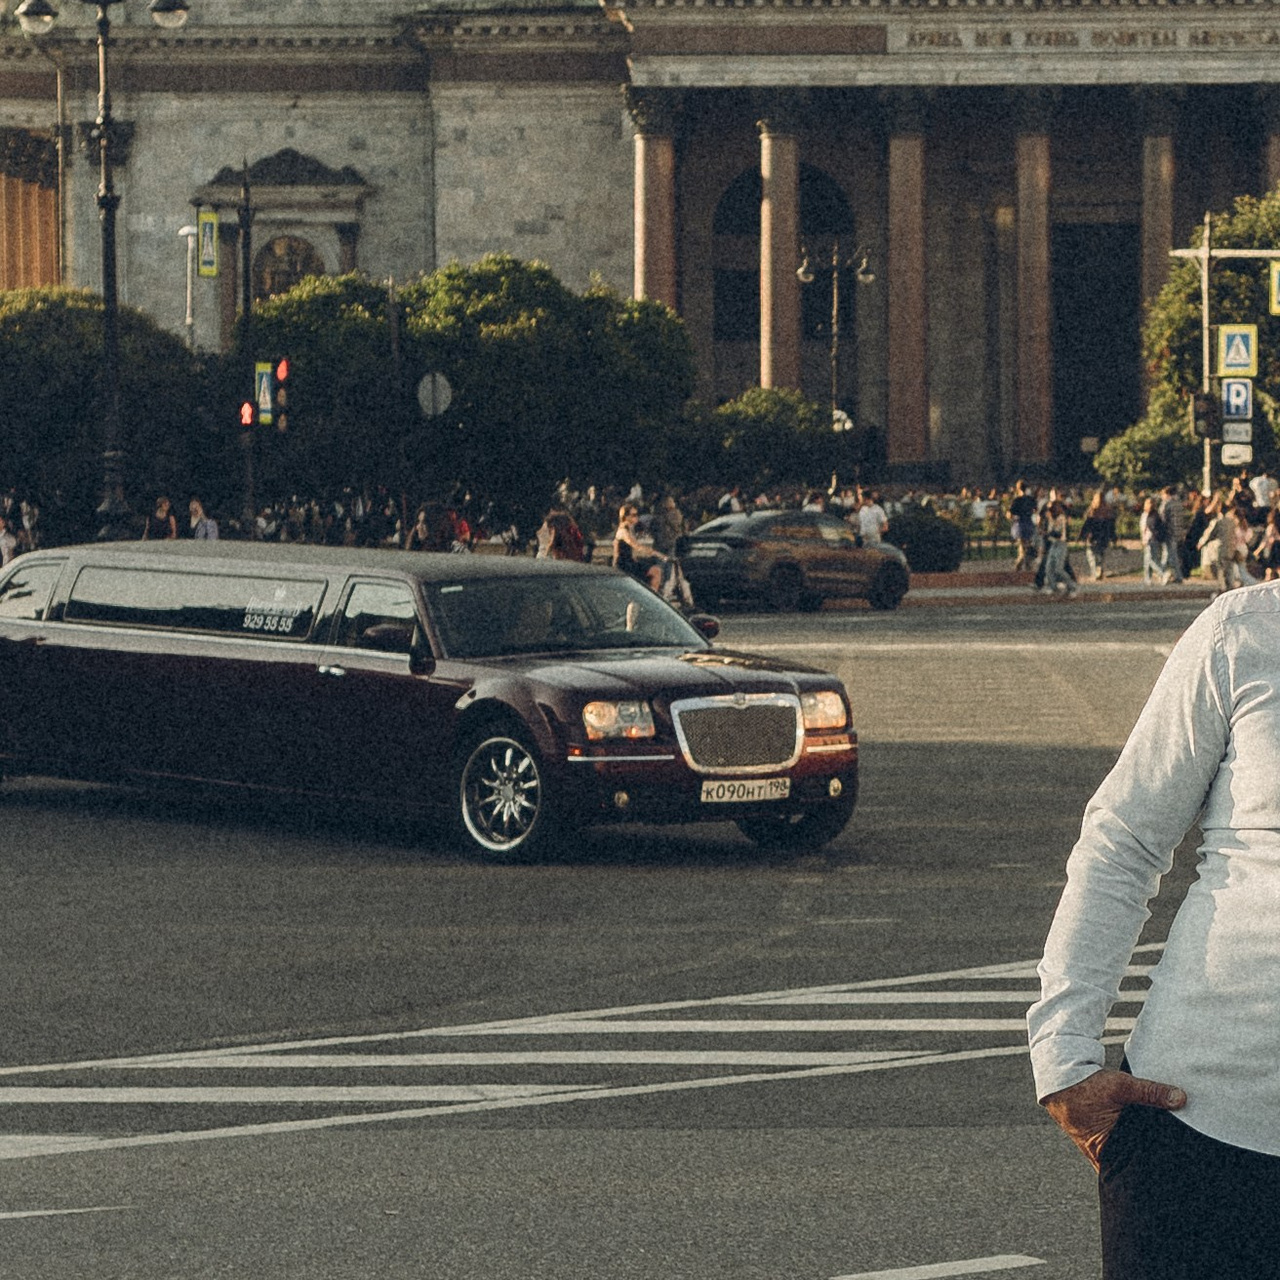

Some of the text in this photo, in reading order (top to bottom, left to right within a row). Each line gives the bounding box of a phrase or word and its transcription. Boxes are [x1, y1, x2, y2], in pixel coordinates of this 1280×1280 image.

[243, 613, 294, 633] 929 55 55
